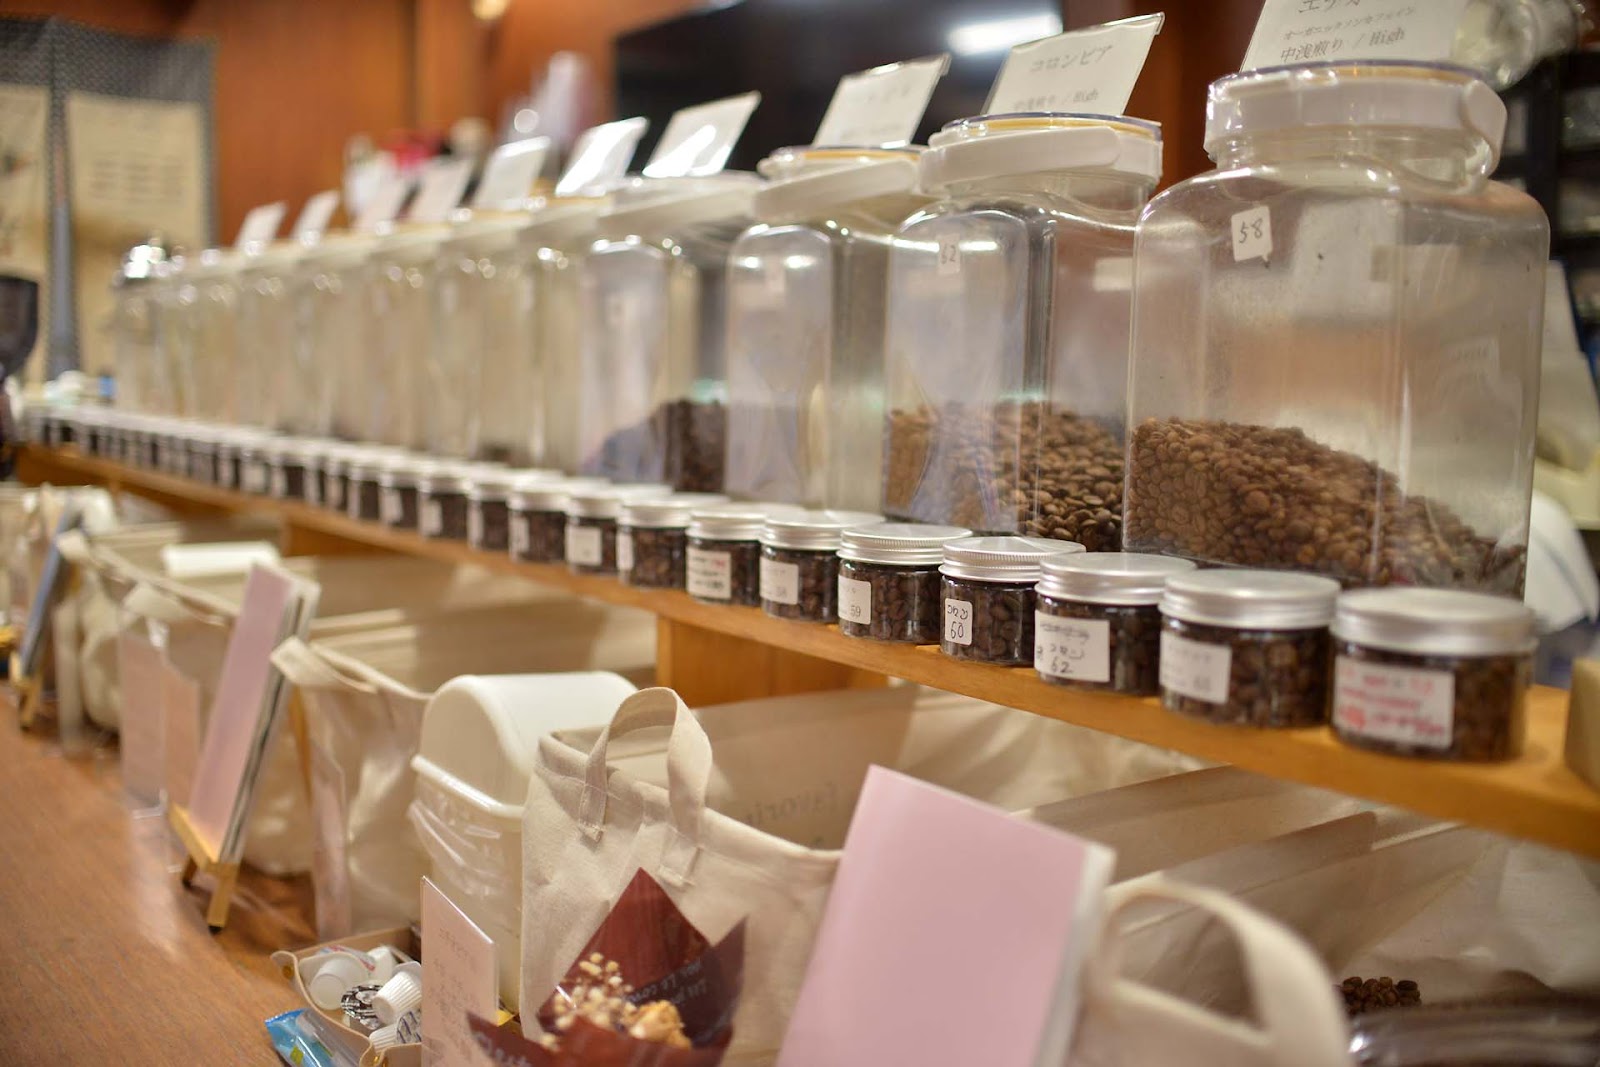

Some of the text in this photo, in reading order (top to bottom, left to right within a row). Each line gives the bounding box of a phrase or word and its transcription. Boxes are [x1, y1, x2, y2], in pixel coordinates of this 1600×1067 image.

[1030, 44, 1113, 73] コロンビア
[1280, 38, 1343, 63] 中浅煎り
[1369, 26, 1405, 47] High
[1238, 217, 1264, 244] 58
